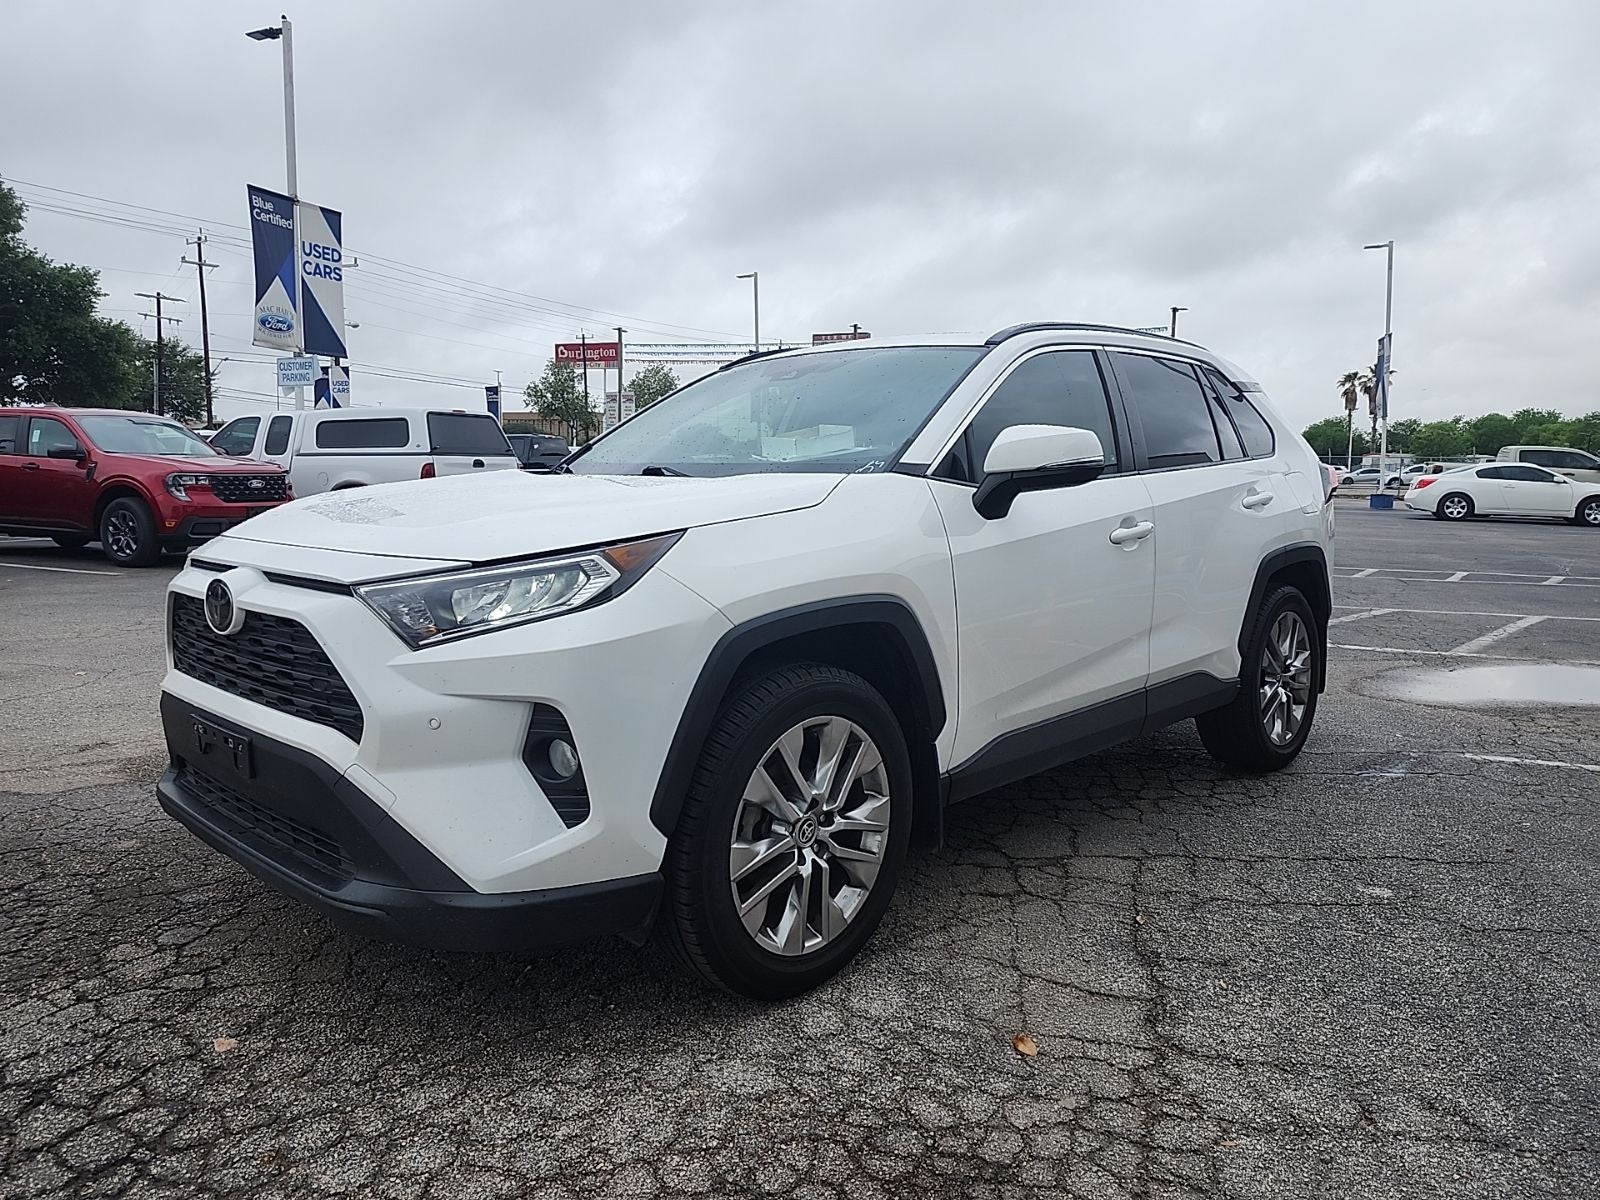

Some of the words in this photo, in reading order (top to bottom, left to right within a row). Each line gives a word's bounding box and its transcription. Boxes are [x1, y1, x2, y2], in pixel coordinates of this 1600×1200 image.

[252, 195, 274, 212] Blue
[253, 208, 293, 229] Certified
[302, 240, 342, 262] USED
[302, 260, 342, 282] CARS
[264, 315, 290, 330] Ford
[558, 346, 616, 360] Burlington
[279, 361, 313, 371] CUSTOMER
[282, 372, 310, 382] PARKING
